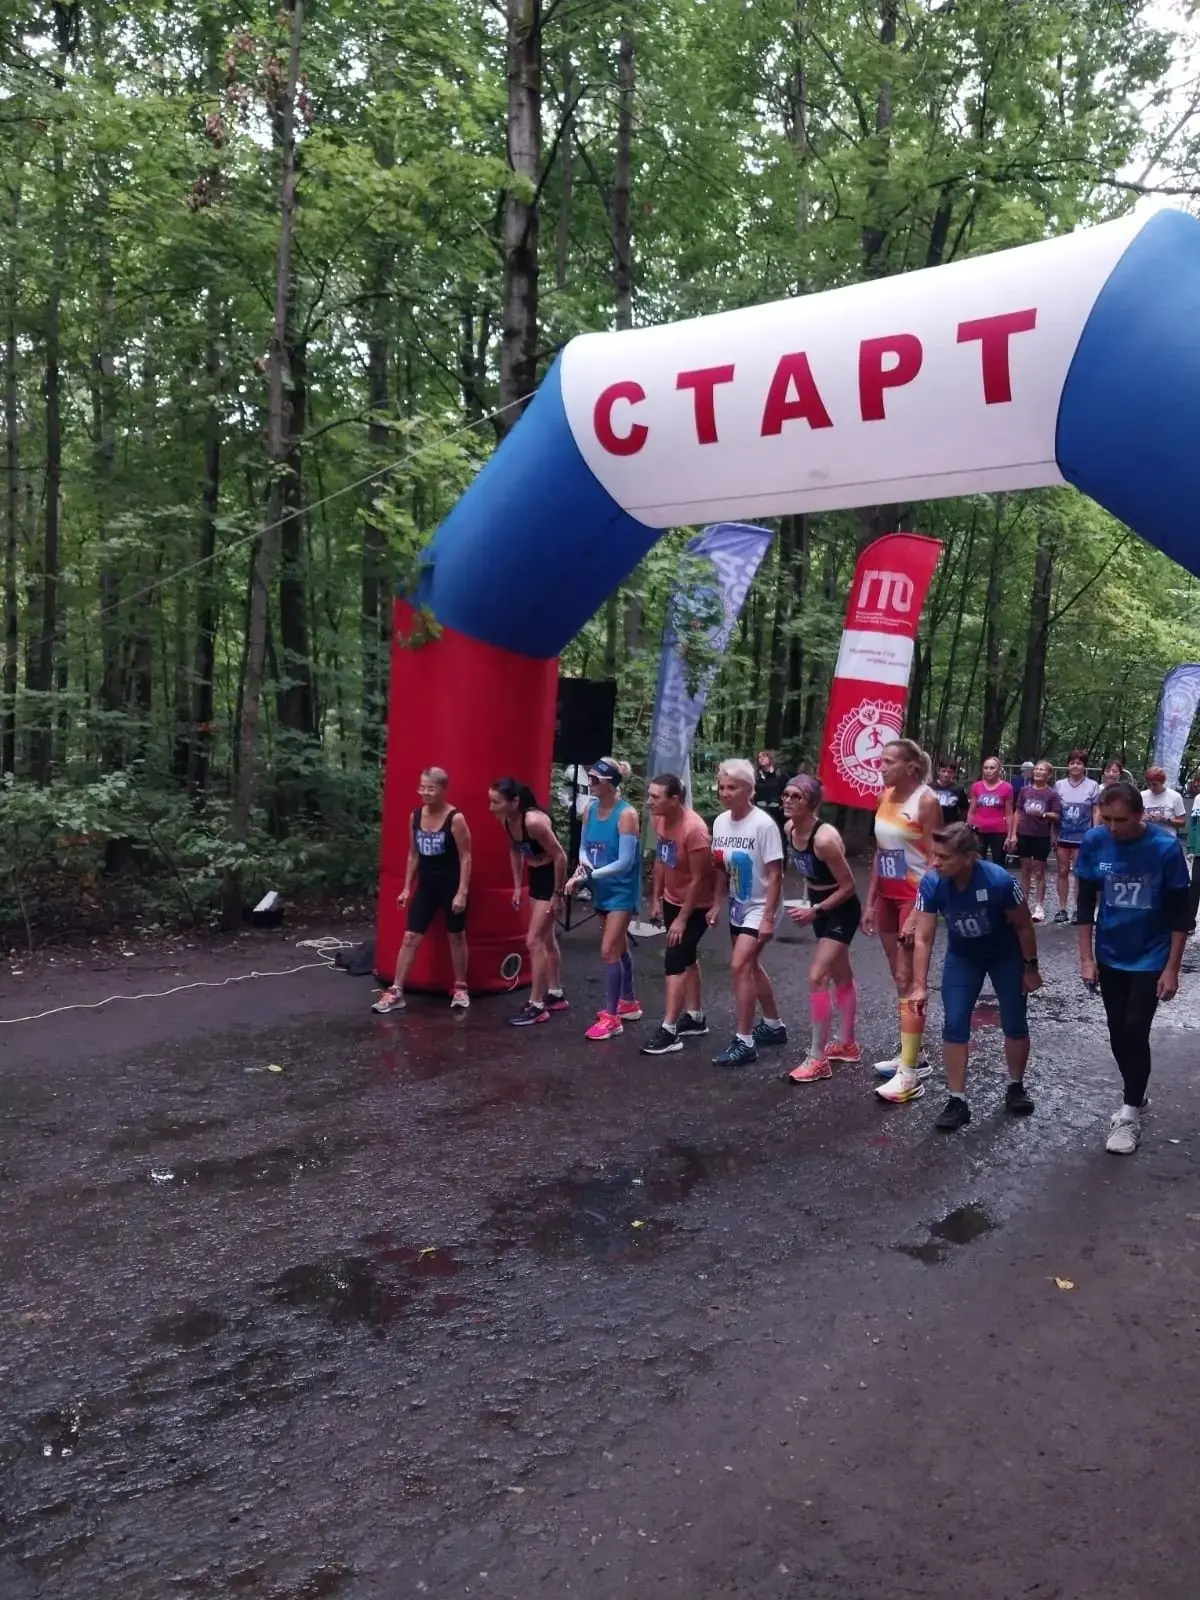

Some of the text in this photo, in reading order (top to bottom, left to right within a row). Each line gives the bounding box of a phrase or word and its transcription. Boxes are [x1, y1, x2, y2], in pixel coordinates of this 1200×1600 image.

[593, 308, 1038, 456] СТАРТ
[417, 838, 441, 856] 165
[713, 837, 755, 850] ХАБАРОВСК
[590, 848, 598, 866] 7
[661, 844, 669, 863] 9
[880, 856, 895, 878] 18
[1113, 882, 1142, 906] 27
[954, 918, 980, 938] 19
